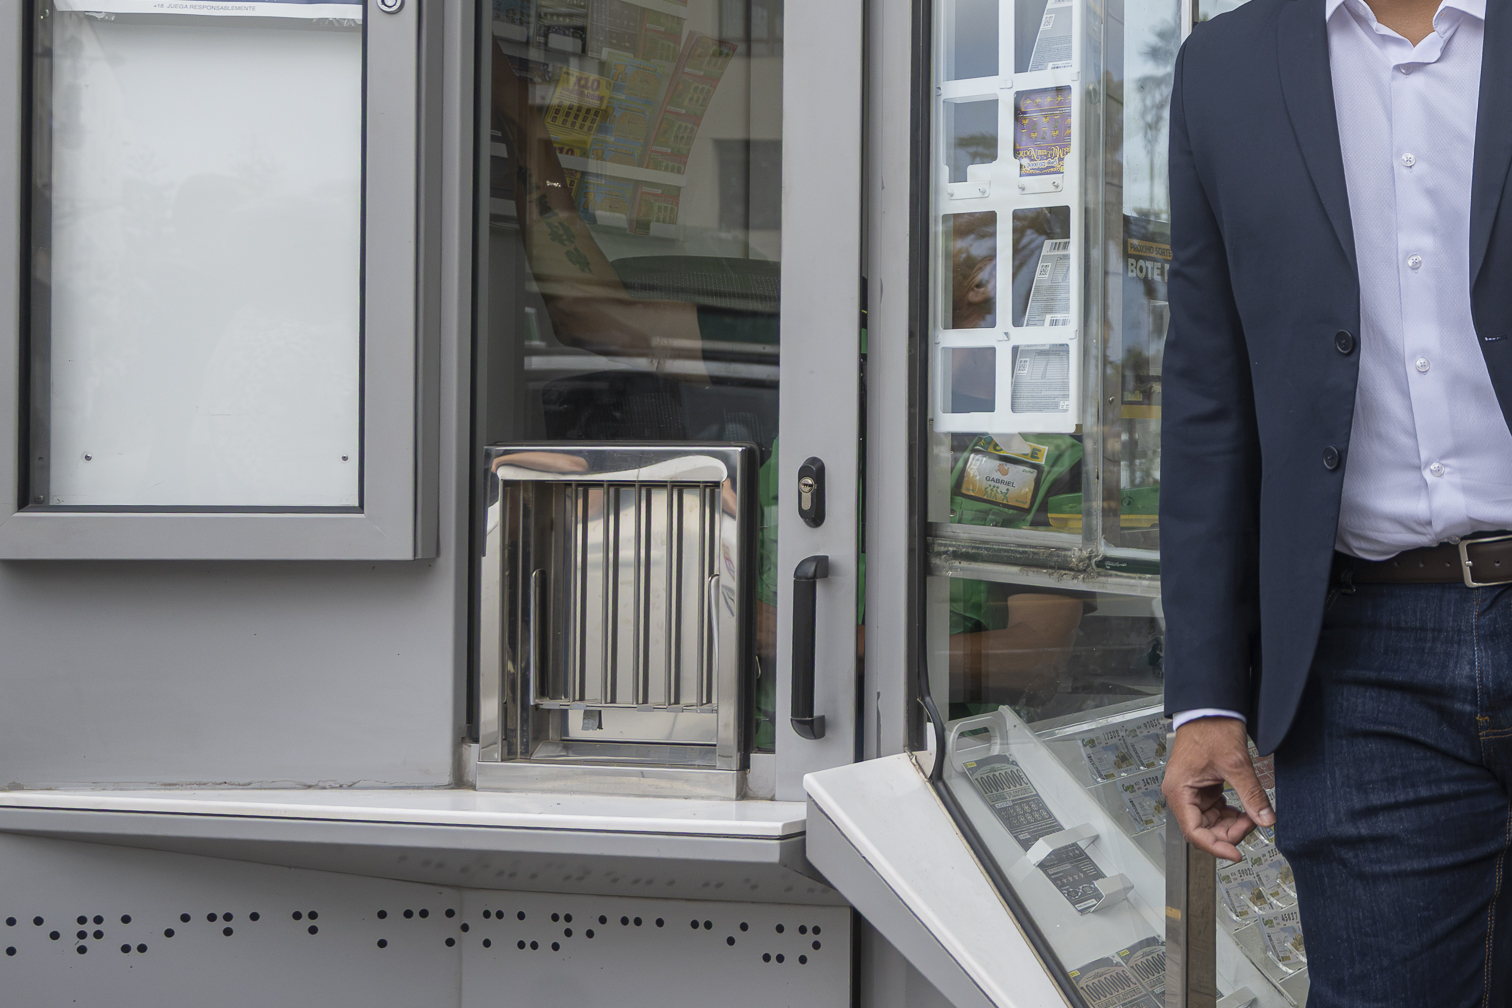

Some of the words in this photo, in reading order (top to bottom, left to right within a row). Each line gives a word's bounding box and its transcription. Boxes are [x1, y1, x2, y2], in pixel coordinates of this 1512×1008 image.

[188, 4, 256, 12] RESPONSABLEMENTE
[1155, 246, 1172, 258] SORTE
[1128, 258, 1162, 282] BOTE
[993, 442, 1042, 460] OE
[985, 475, 1016, 488] GABRIEL
